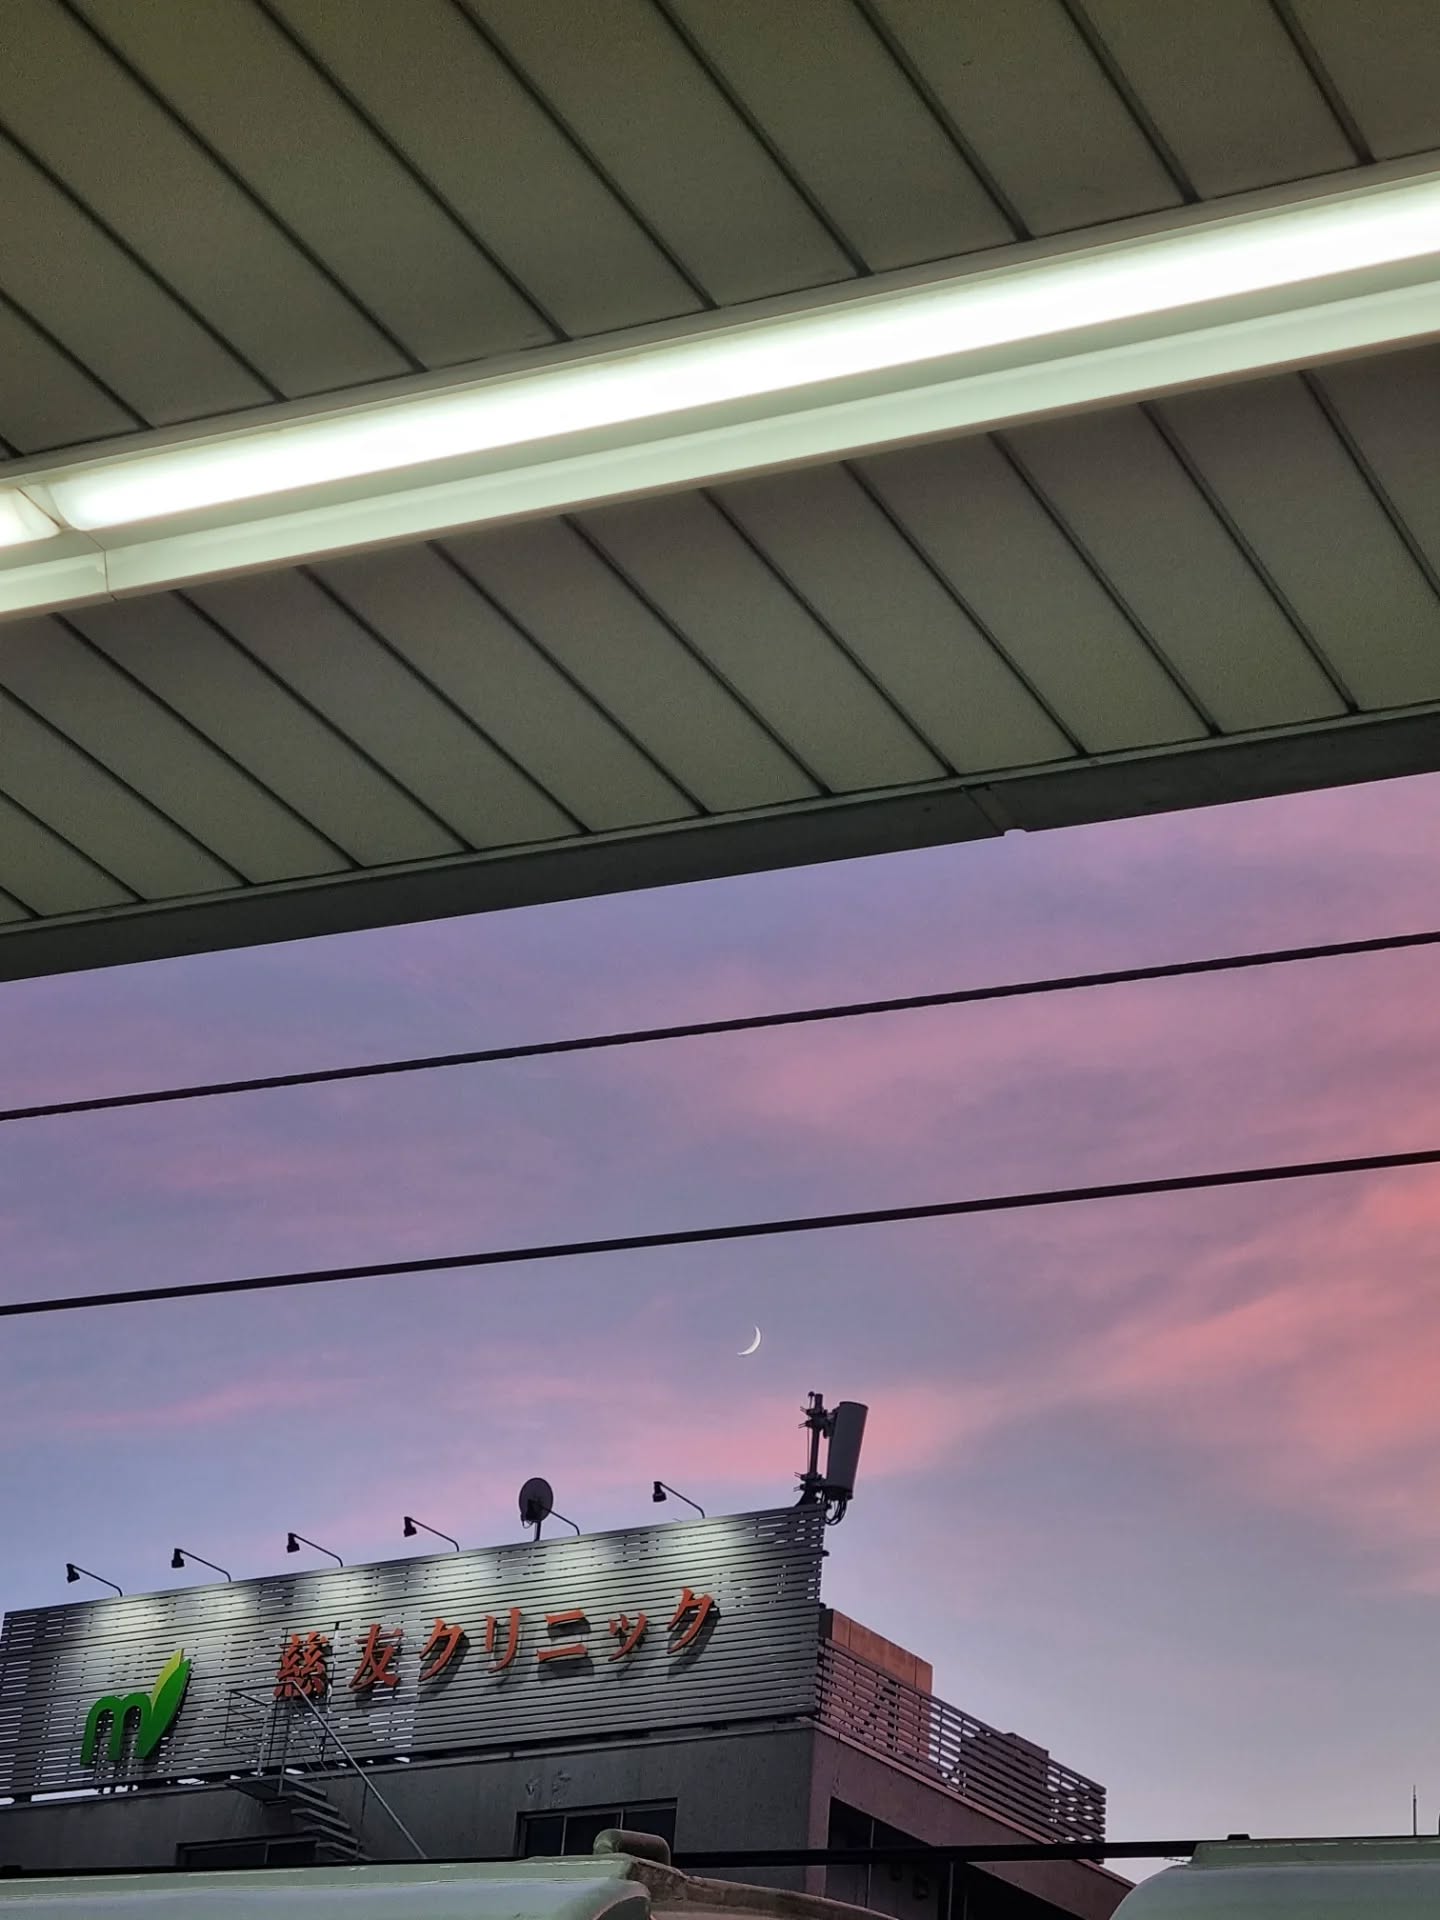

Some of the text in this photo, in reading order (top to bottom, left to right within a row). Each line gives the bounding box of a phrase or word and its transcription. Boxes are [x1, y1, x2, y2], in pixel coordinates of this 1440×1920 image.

[273, 1586, 715, 1697] 慈友クリニック
